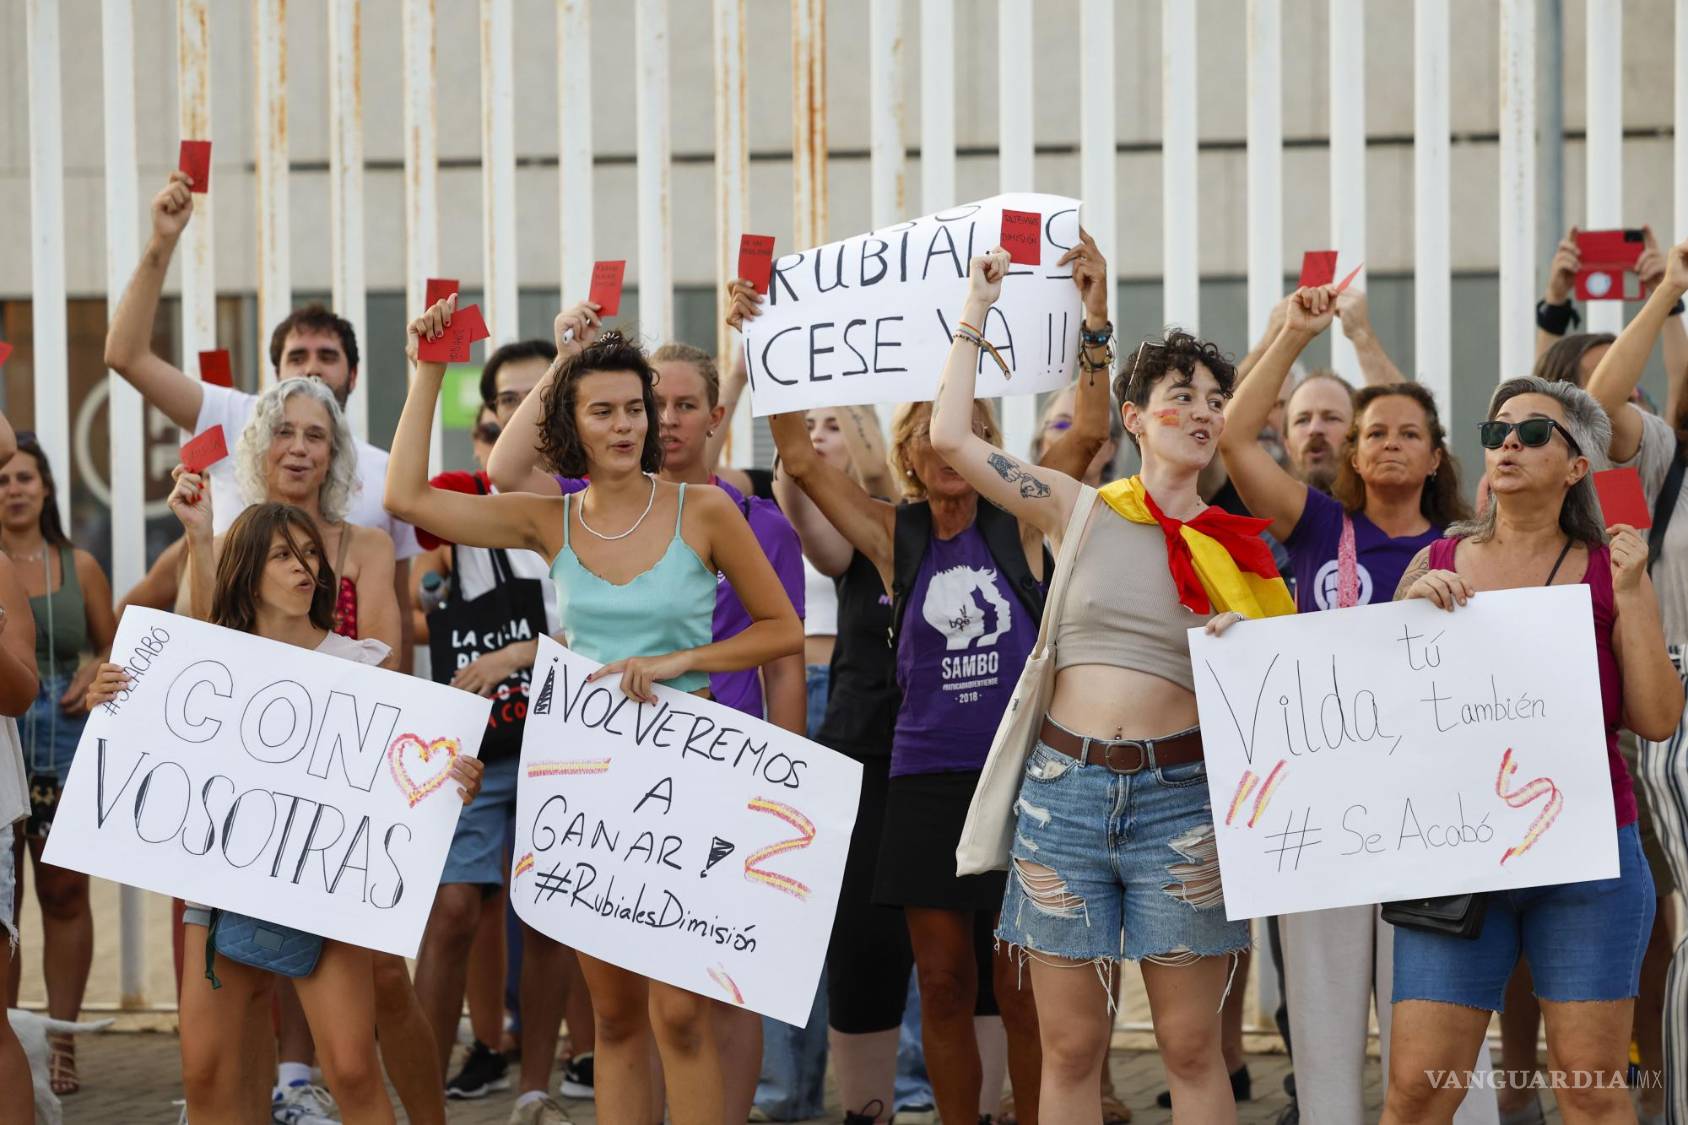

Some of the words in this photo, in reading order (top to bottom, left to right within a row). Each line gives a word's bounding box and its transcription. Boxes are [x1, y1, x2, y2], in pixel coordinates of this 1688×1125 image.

[768, 208, 1078, 306] RUBIALS
[451, 629, 477, 648] LA
[941, 651, 999, 680] SAMBO
[1396, 623, 1446, 671] tú
[164, 659, 402, 792] CON
[958, 690, 979, 704] 2018
[1205, 652, 1403, 765] Vilda,
[1420, 674, 1547, 733] también
[95, 737, 412, 909] VOSOTRAS
[633, 777, 673, 815] A
[1397, 792, 1494, 851] Acabó
[534, 861, 758, 953] #RubialesDimisión
